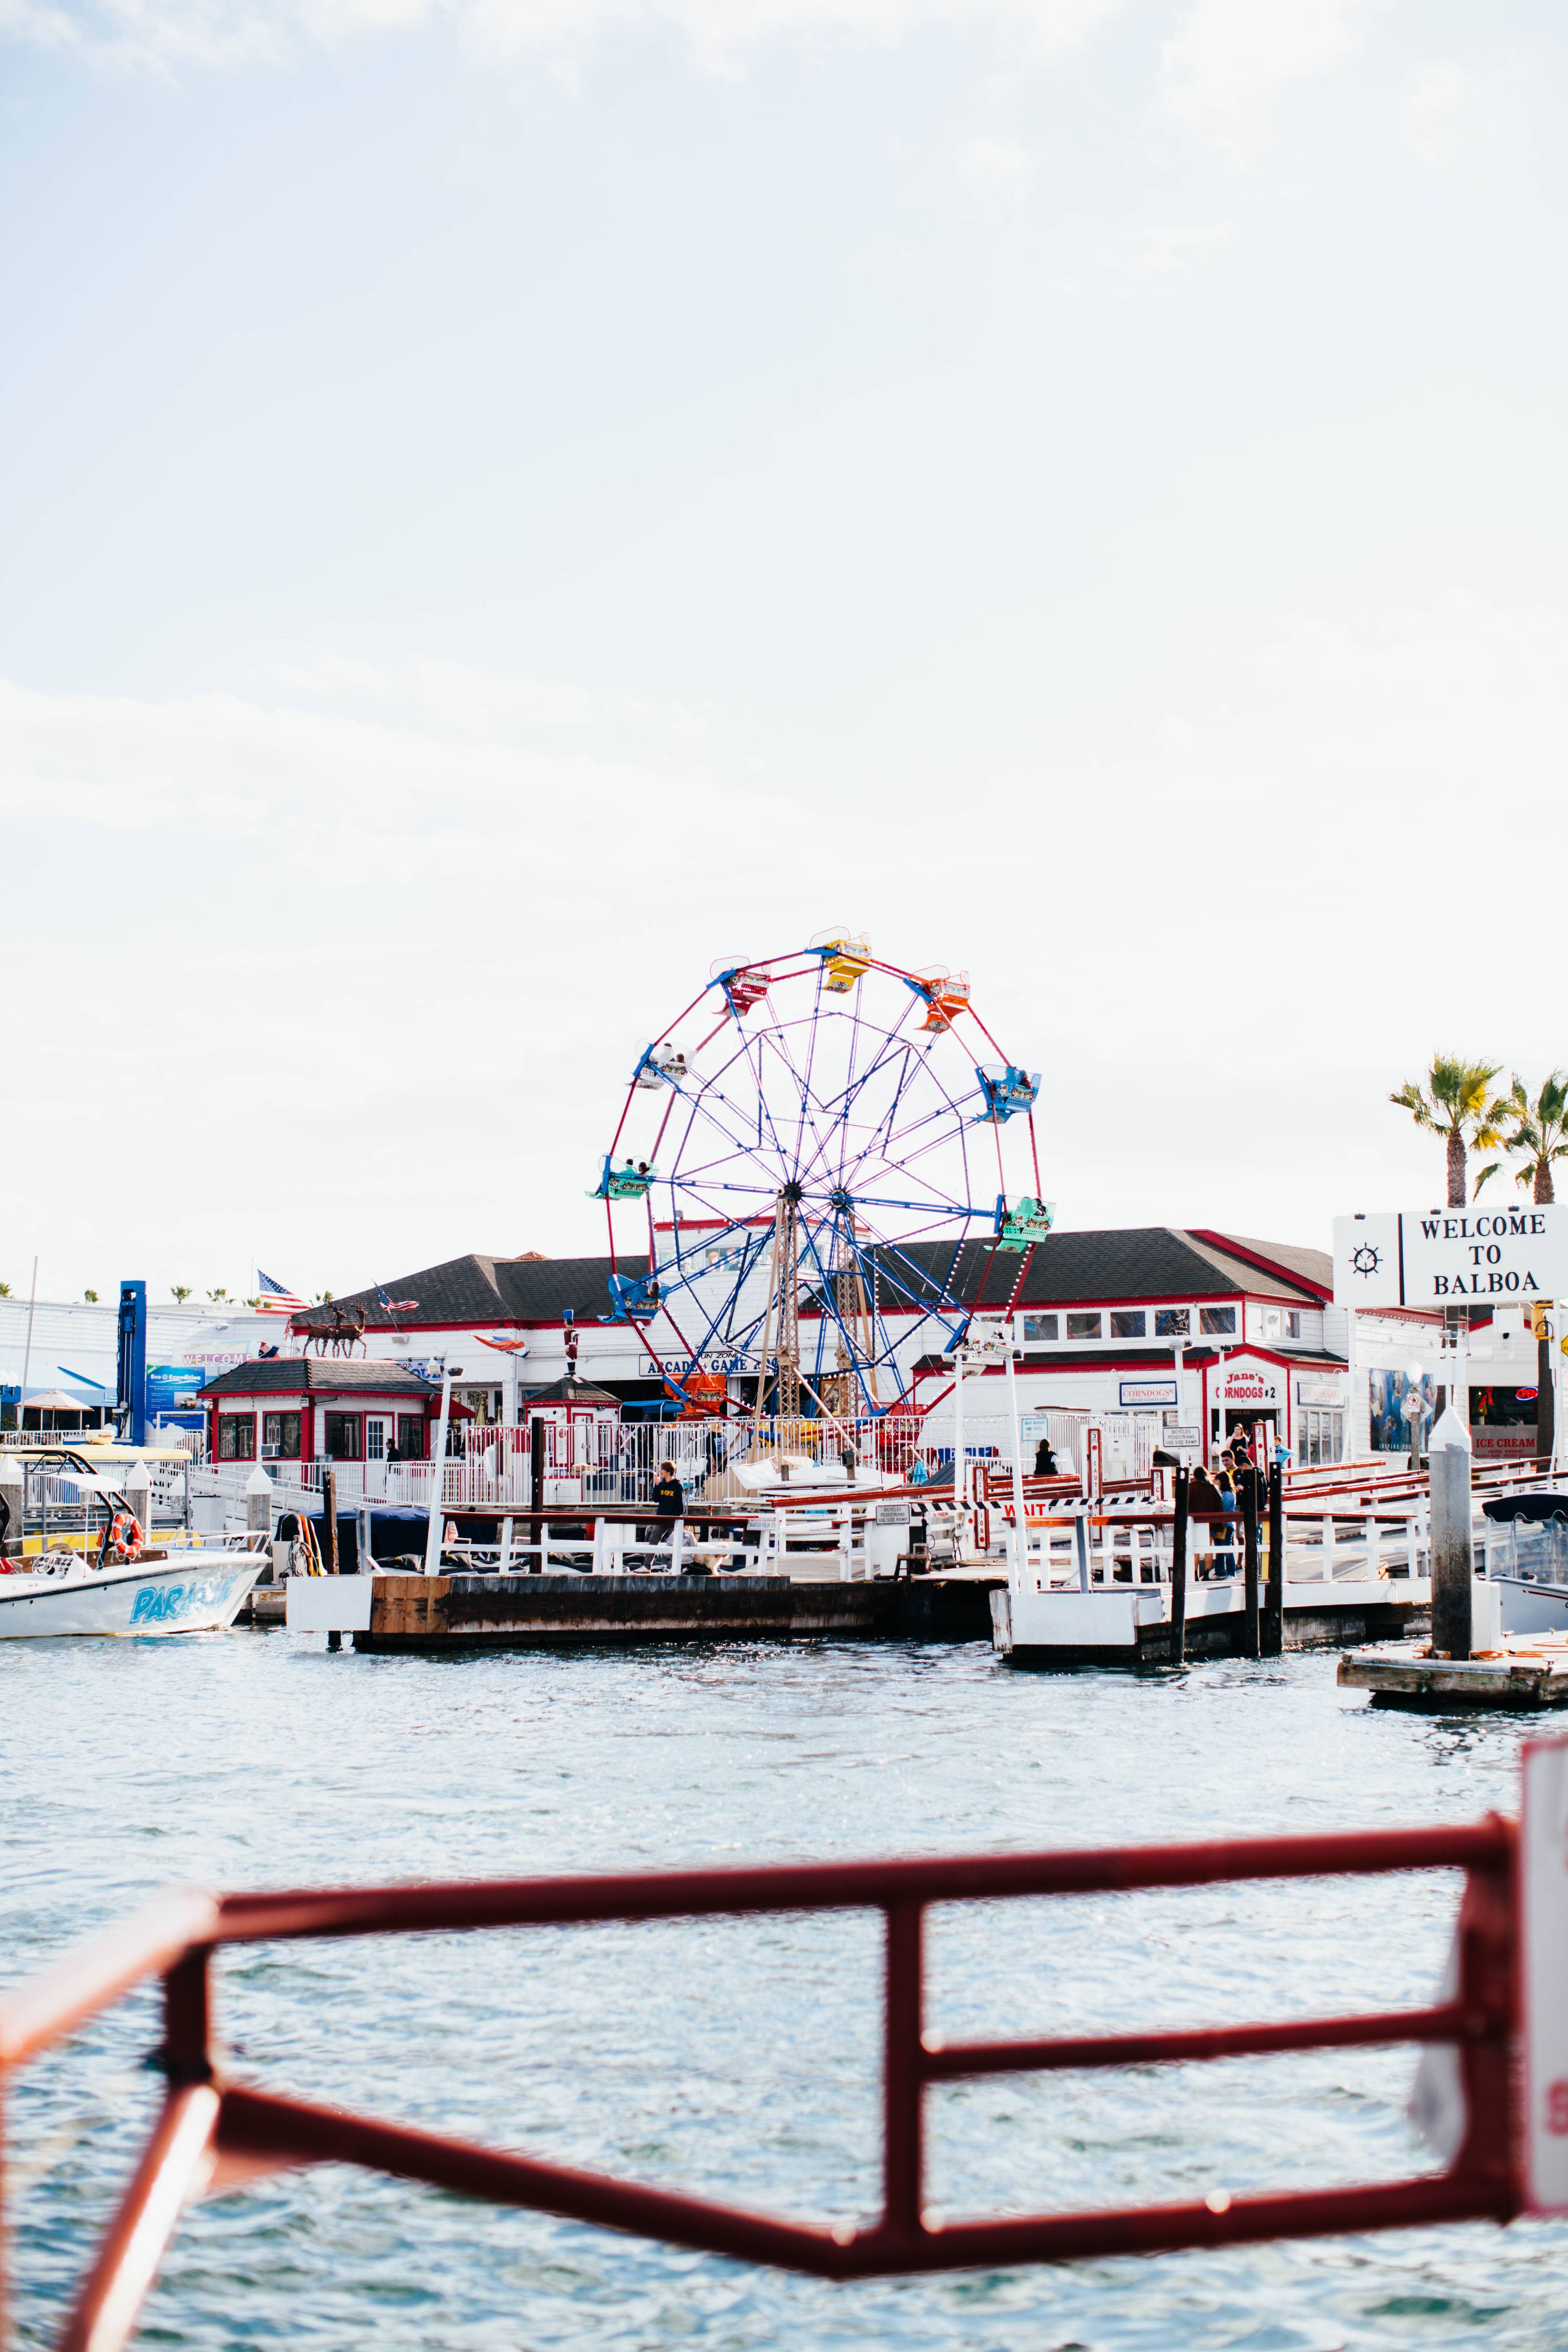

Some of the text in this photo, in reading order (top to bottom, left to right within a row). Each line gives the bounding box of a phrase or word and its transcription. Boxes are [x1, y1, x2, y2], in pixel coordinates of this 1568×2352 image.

[1420, 1214, 1545, 1239] WELCOME
[1469, 1245, 1501, 1265] TO
[1433, 1271, 1540, 1295] BALBOA
[182, 1353, 253, 1366] WELCOME
[1227, 1373, 1264, 1384] Jane's
[1123, 1389, 1170, 1397] CORNDOGS
[1316, 1387, 1340, 1400] CORNDOG
[1516, 1388, 1538, 1398] OPEN
[1476, 1438, 1535, 1447] ICE CREAM
[1004, 1504, 1046, 1516] WAIT
